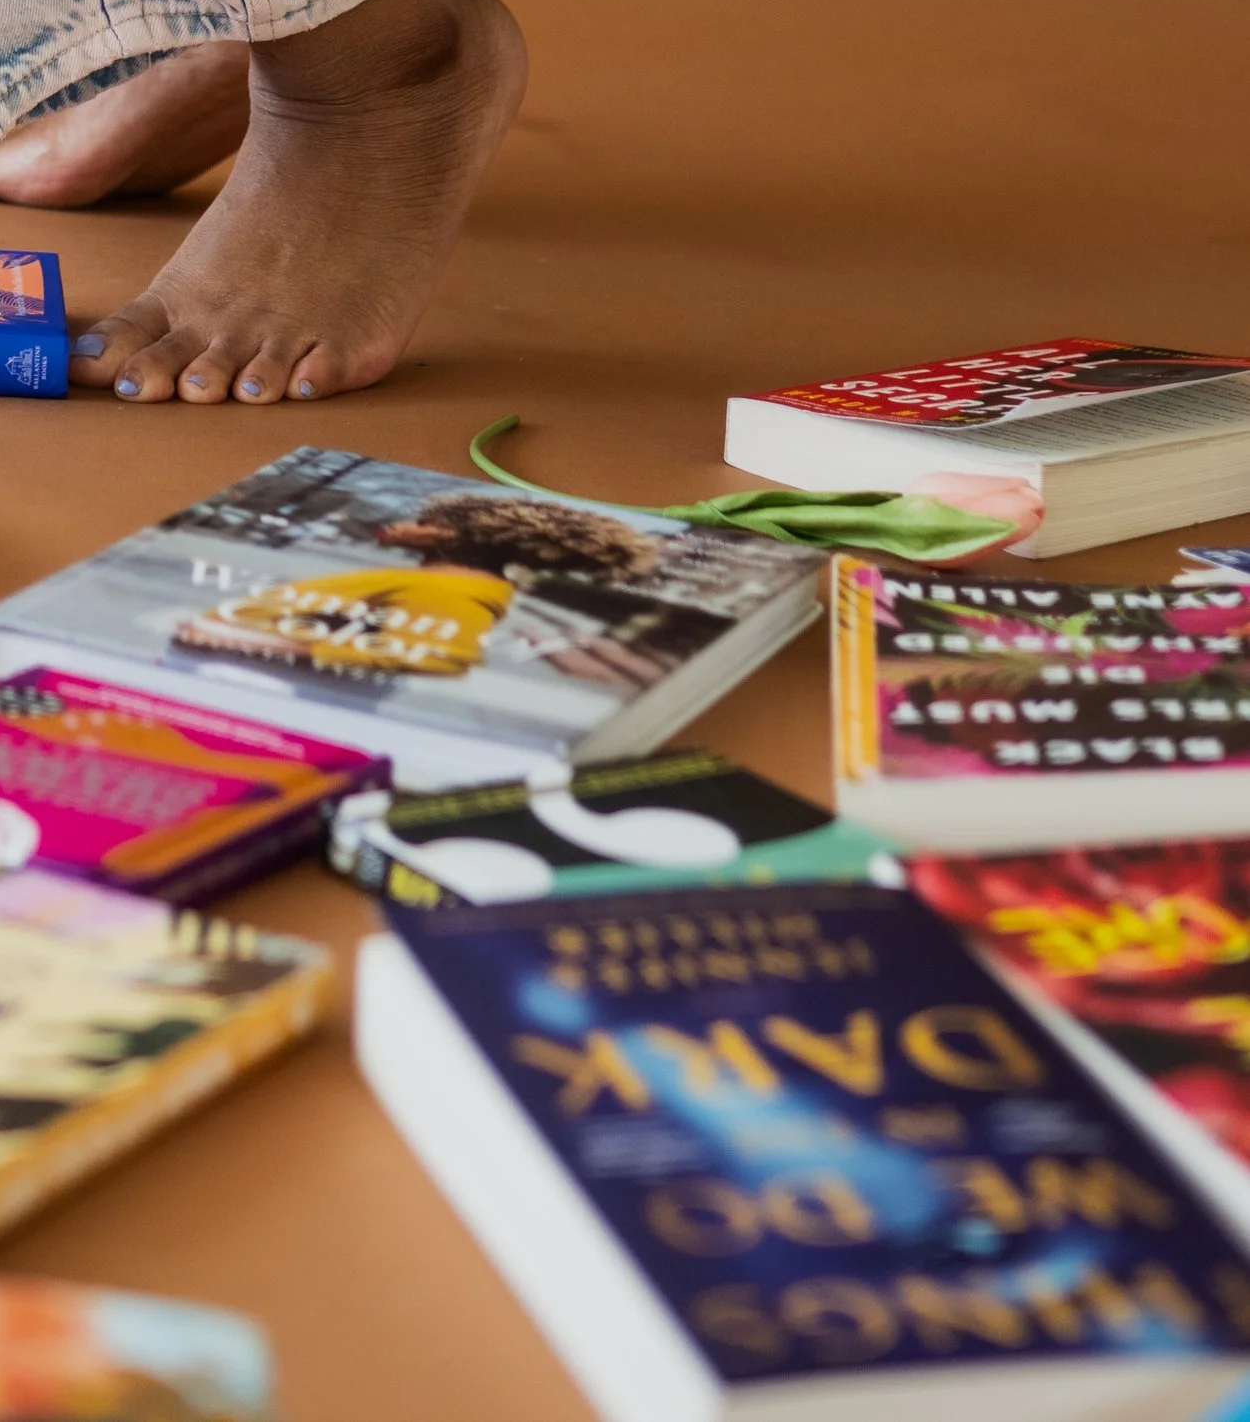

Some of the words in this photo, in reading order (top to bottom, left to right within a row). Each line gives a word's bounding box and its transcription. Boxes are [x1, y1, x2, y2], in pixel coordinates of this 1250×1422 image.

[33, 345, 42, 390] BALLANTINE
[943, 358, 1078, 383] HER
[1001, 347, 1120, 370] ALL
[782, 390, 885, 411] WANDA
[820, 380, 1020, 415] SECRE
[883, 580, 1060, 608] ALLEN
[1090, 590, 1244, 610] AYNE
[892, 632, 1243, 653] XHAUSTED
[889, 699, 1079, 724] MUST
[992, 736, 1225, 766] BLACK
